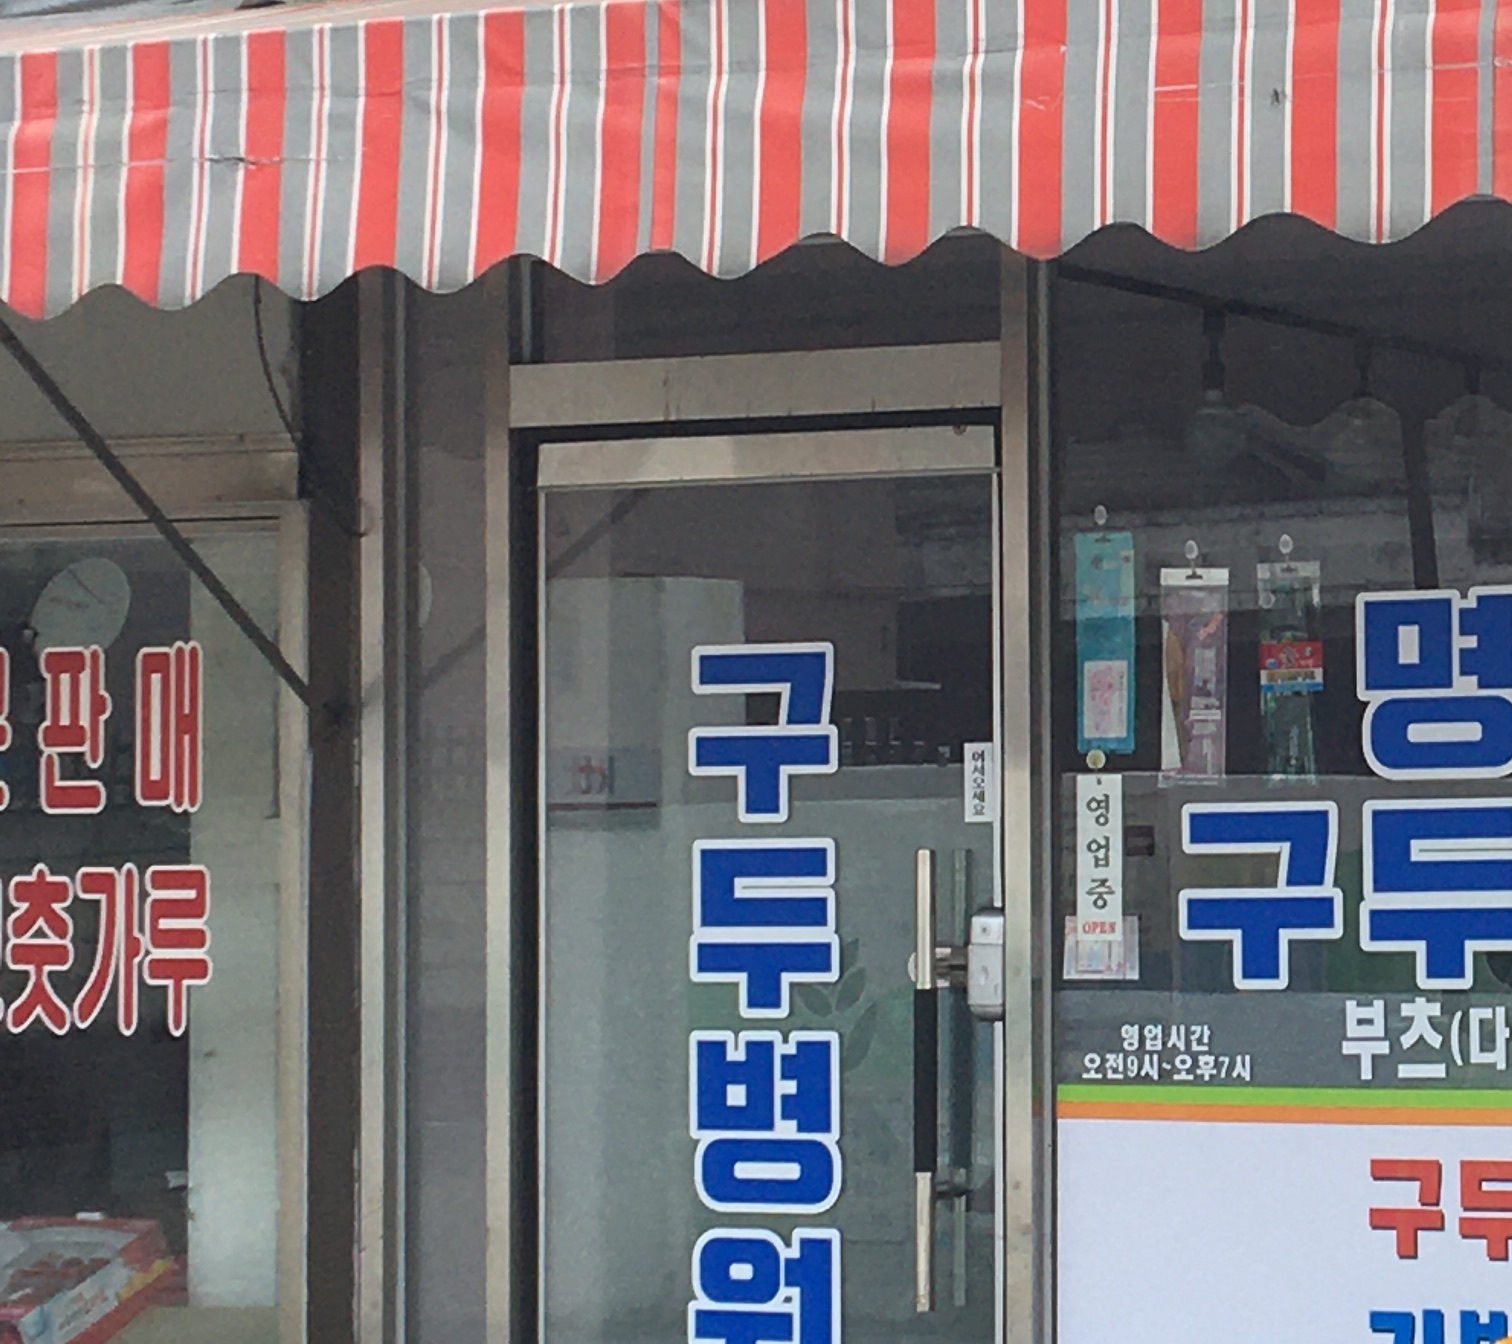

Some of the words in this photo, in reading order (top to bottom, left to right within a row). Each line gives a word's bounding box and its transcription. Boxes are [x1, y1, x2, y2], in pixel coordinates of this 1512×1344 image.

[0, 641, 202, 815] 판매
[971, 749, 986, 816] 어서오세요
[1085, 793, 1116, 910] 영업중
[0, 861, 212, 1037] 춧가루
[1082, 920, 1117, 935] OPEN
[1081, 1053, 1251, 1083] 오전9시~오후7시
[1120, 1024, 1211, 1052] 영업시간
